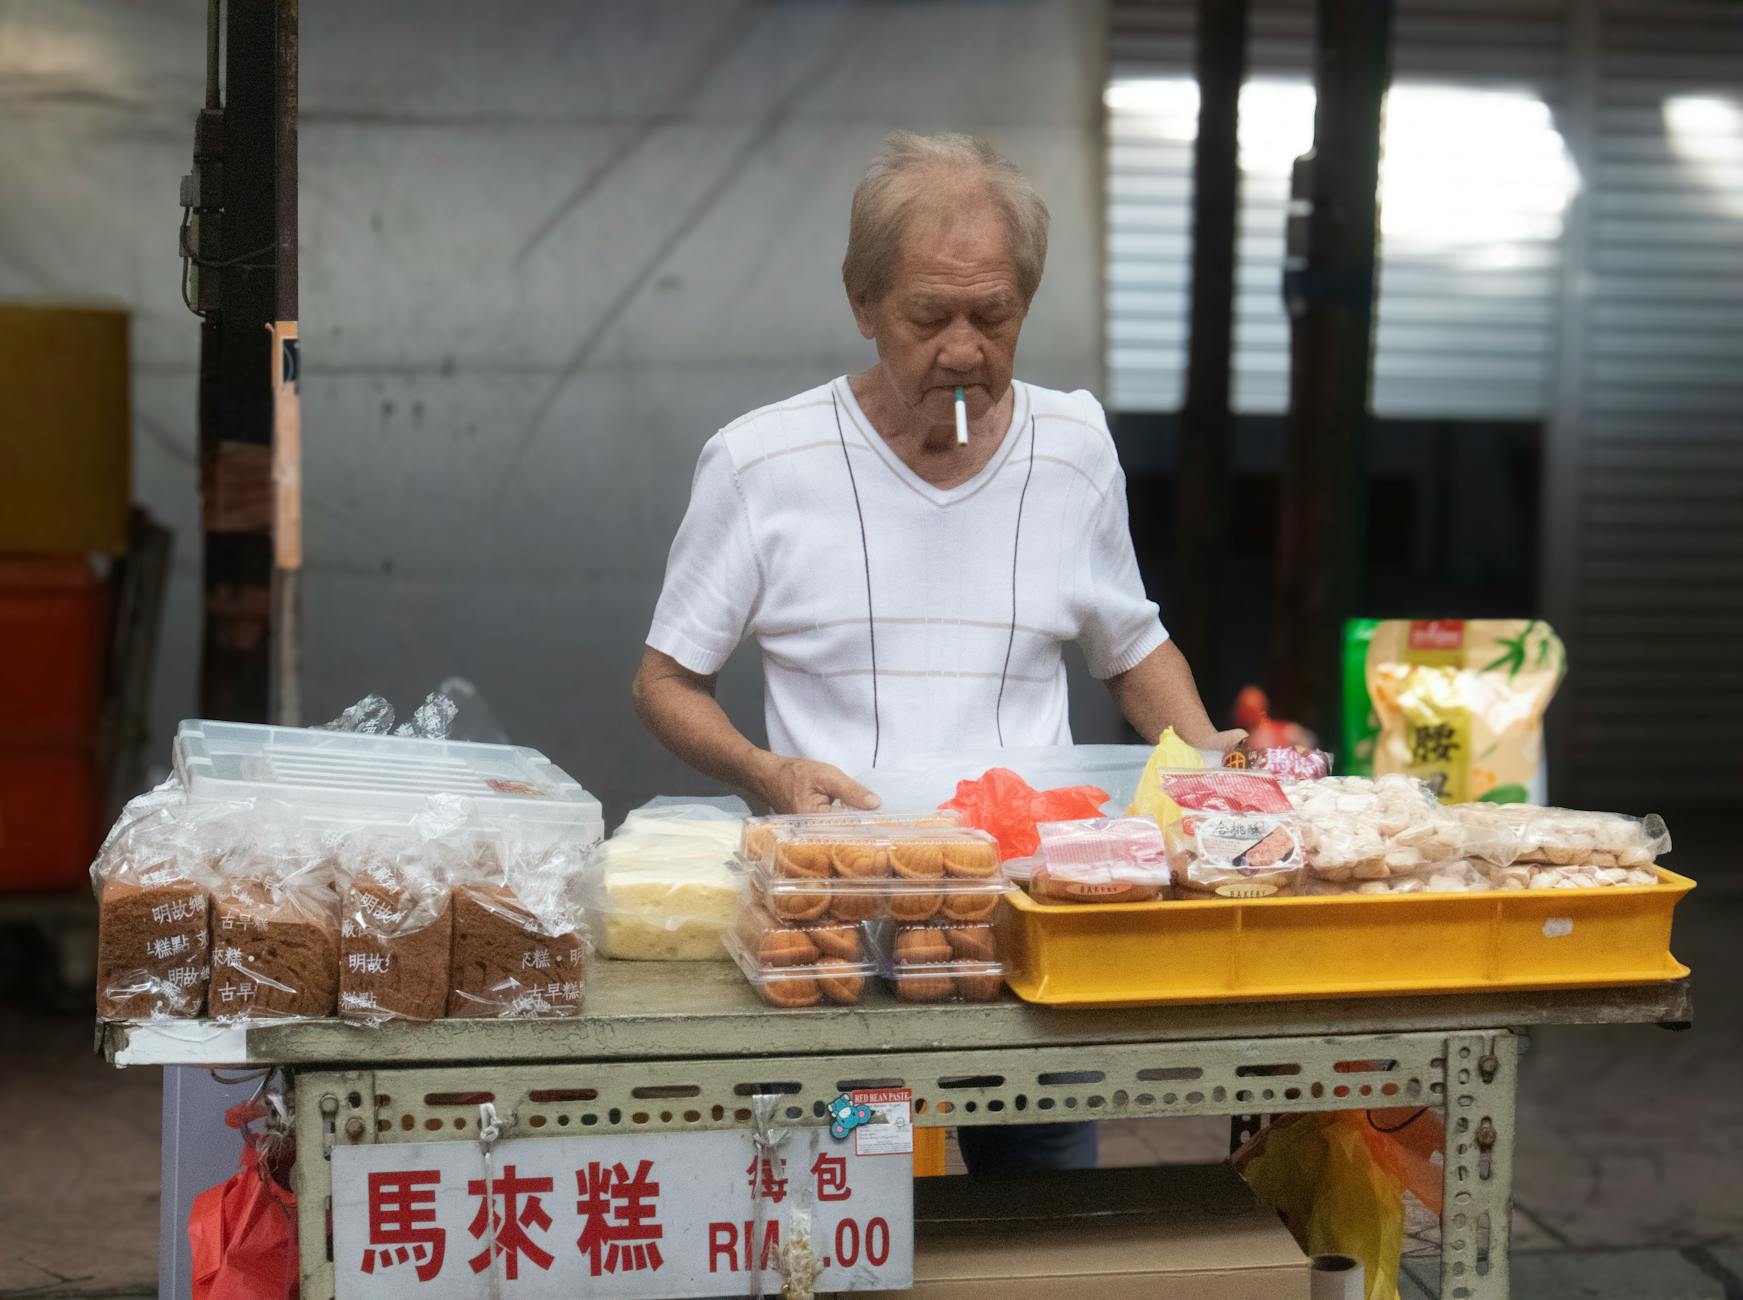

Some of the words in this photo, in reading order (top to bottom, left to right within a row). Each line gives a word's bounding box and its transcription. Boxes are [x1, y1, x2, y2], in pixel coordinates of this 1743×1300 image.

[1230, 889, 1267, 897] BAKERY
[146, 934, 190, 959] 糕點
[349, 952, 391, 974] 明故
[217, 981, 258, 1003] 古早
[854, 1094, 869, 1103] RED
[870, 1092, 888, 1102] BEAN
[889, 1091, 912, 1102] PASTE
[360, 1159, 664, 1283] 馬來糕
[708, 1216, 890, 1273] RM.00
